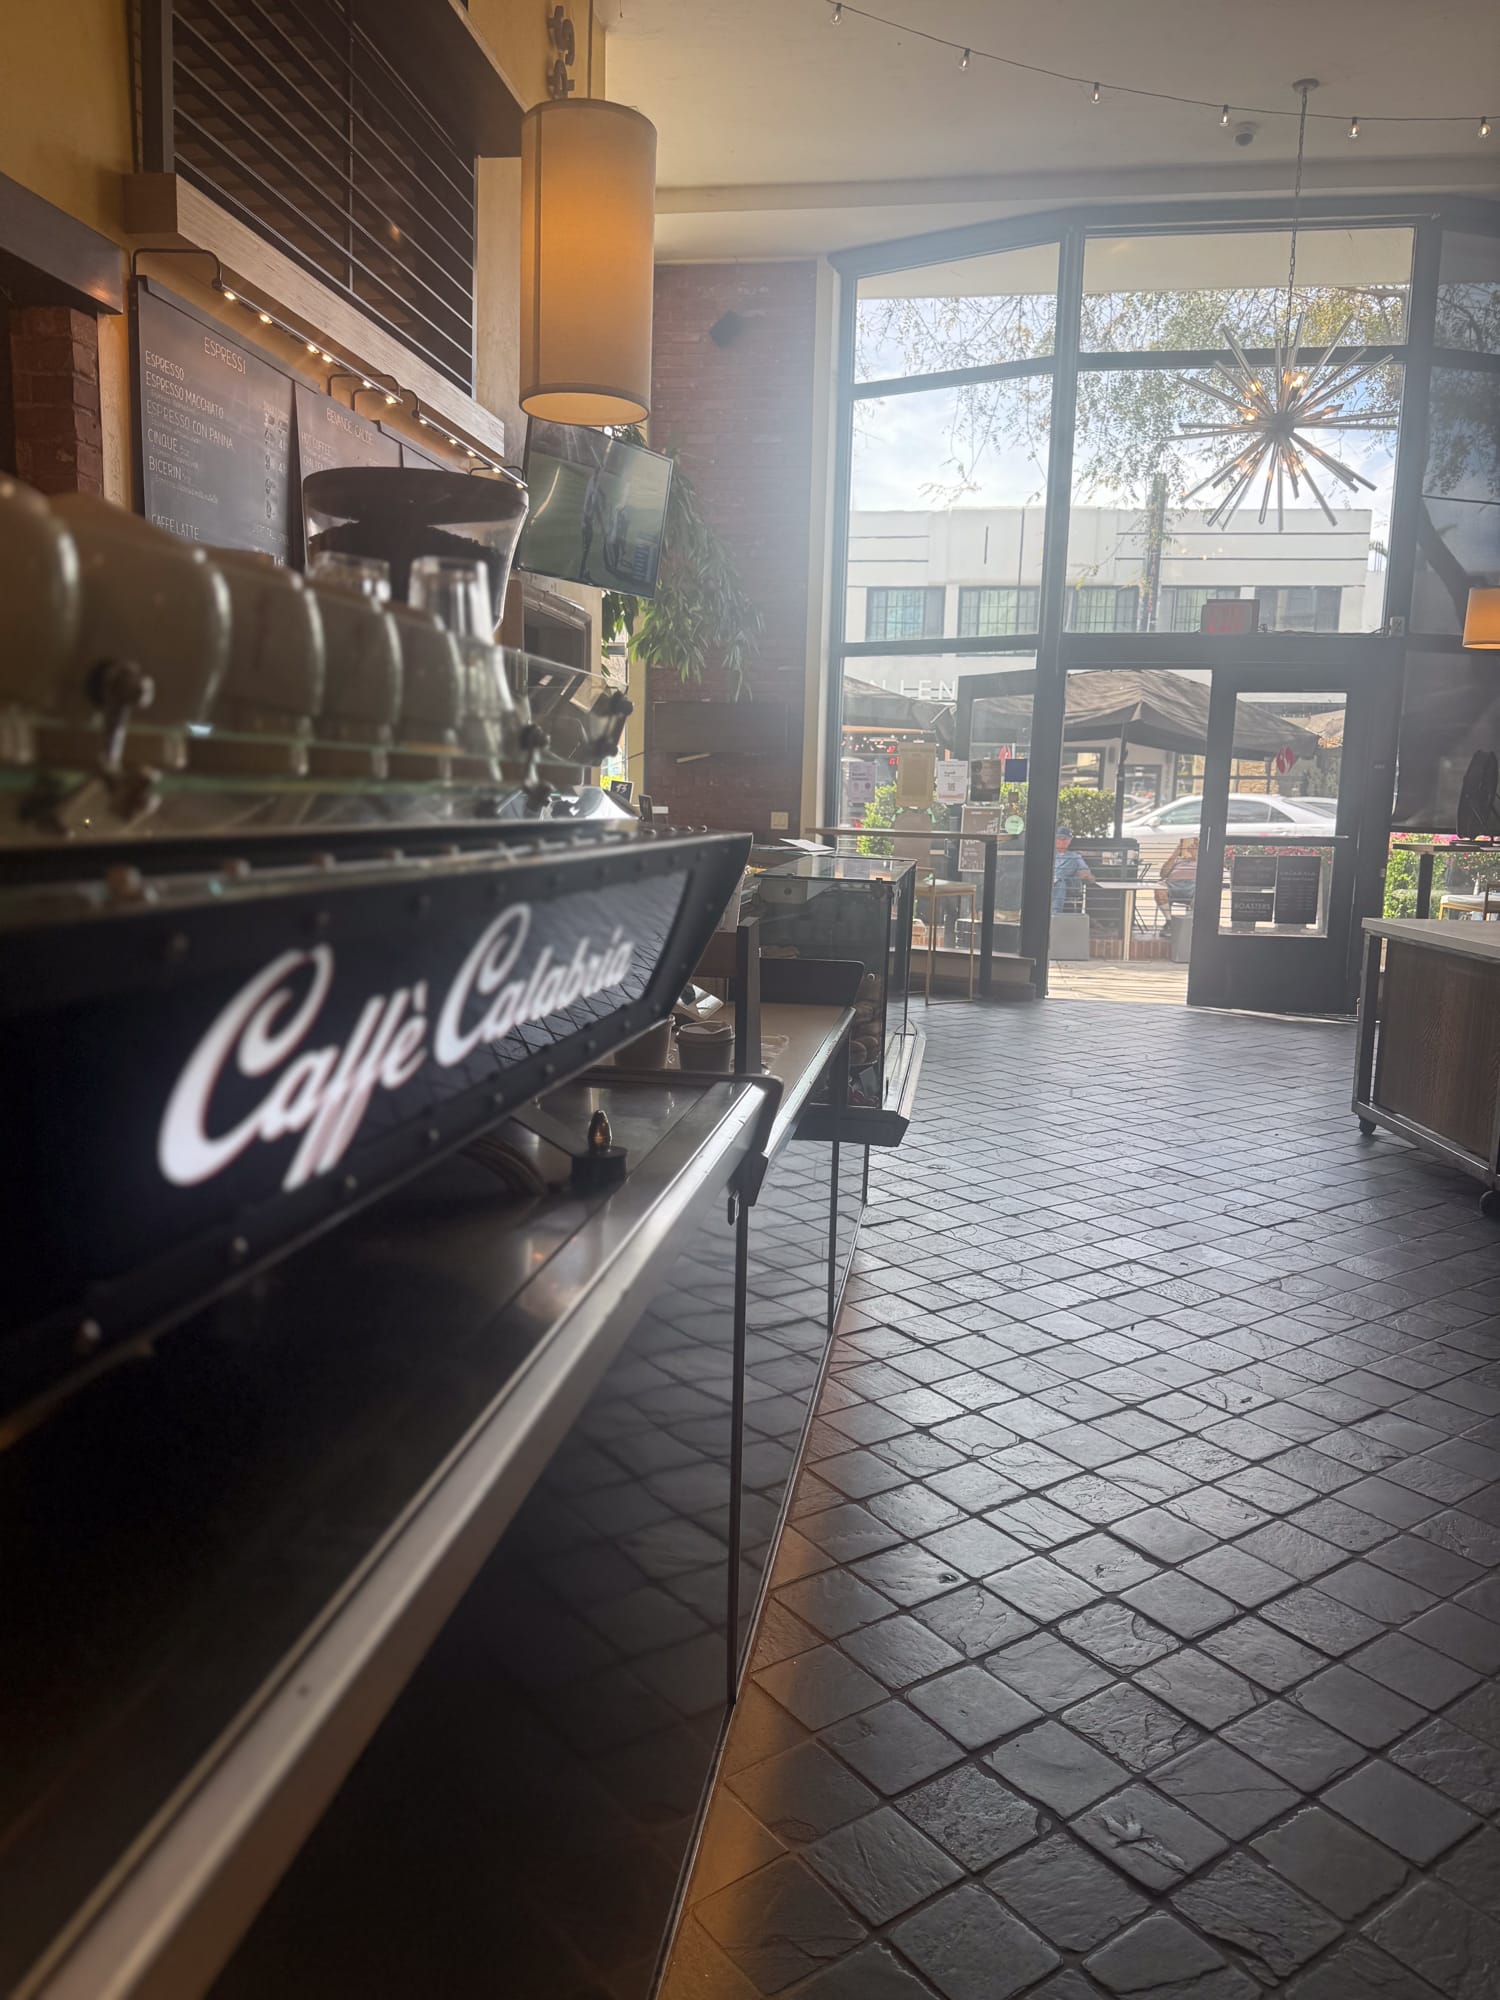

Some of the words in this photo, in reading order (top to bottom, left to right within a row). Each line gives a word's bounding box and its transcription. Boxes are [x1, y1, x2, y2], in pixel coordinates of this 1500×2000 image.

[145, 350, 185, 381] ESPRESSO
[204, 336, 246, 374] ESPRESSI
[146, 371, 184, 400] ESPRESSO
[185, 389, 224, 419] MACCHIATO
[146, 400, 191, 431] ESPRESSO
[192, 420, 208, 439] CON
[209, 427, 233, 449] PANNA
[147, 428, 178, 454] CINQUE
[149, 455, 182, 481] BICERIN
[175, 520, 200, 541] LATTE
[434, 902, 636, 1068] Calabria
